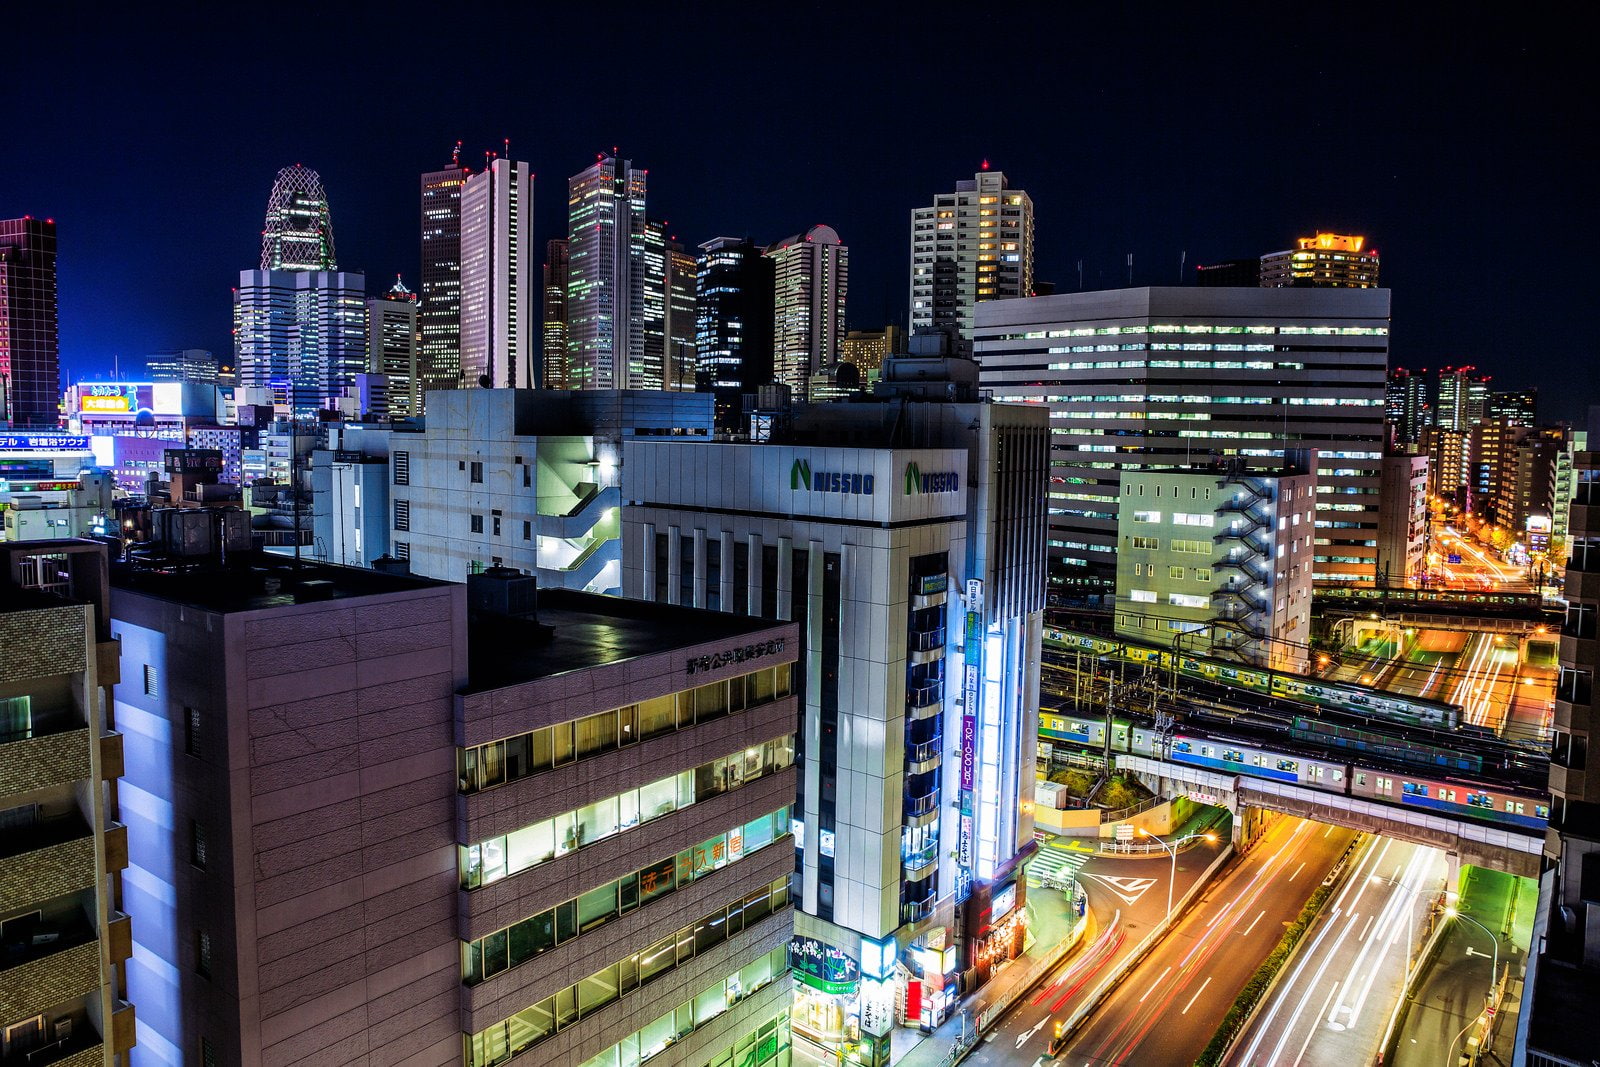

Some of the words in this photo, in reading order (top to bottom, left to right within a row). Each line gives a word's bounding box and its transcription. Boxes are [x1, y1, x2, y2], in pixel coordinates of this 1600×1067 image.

[641, 835, 743, 896] 法テラス新宿
